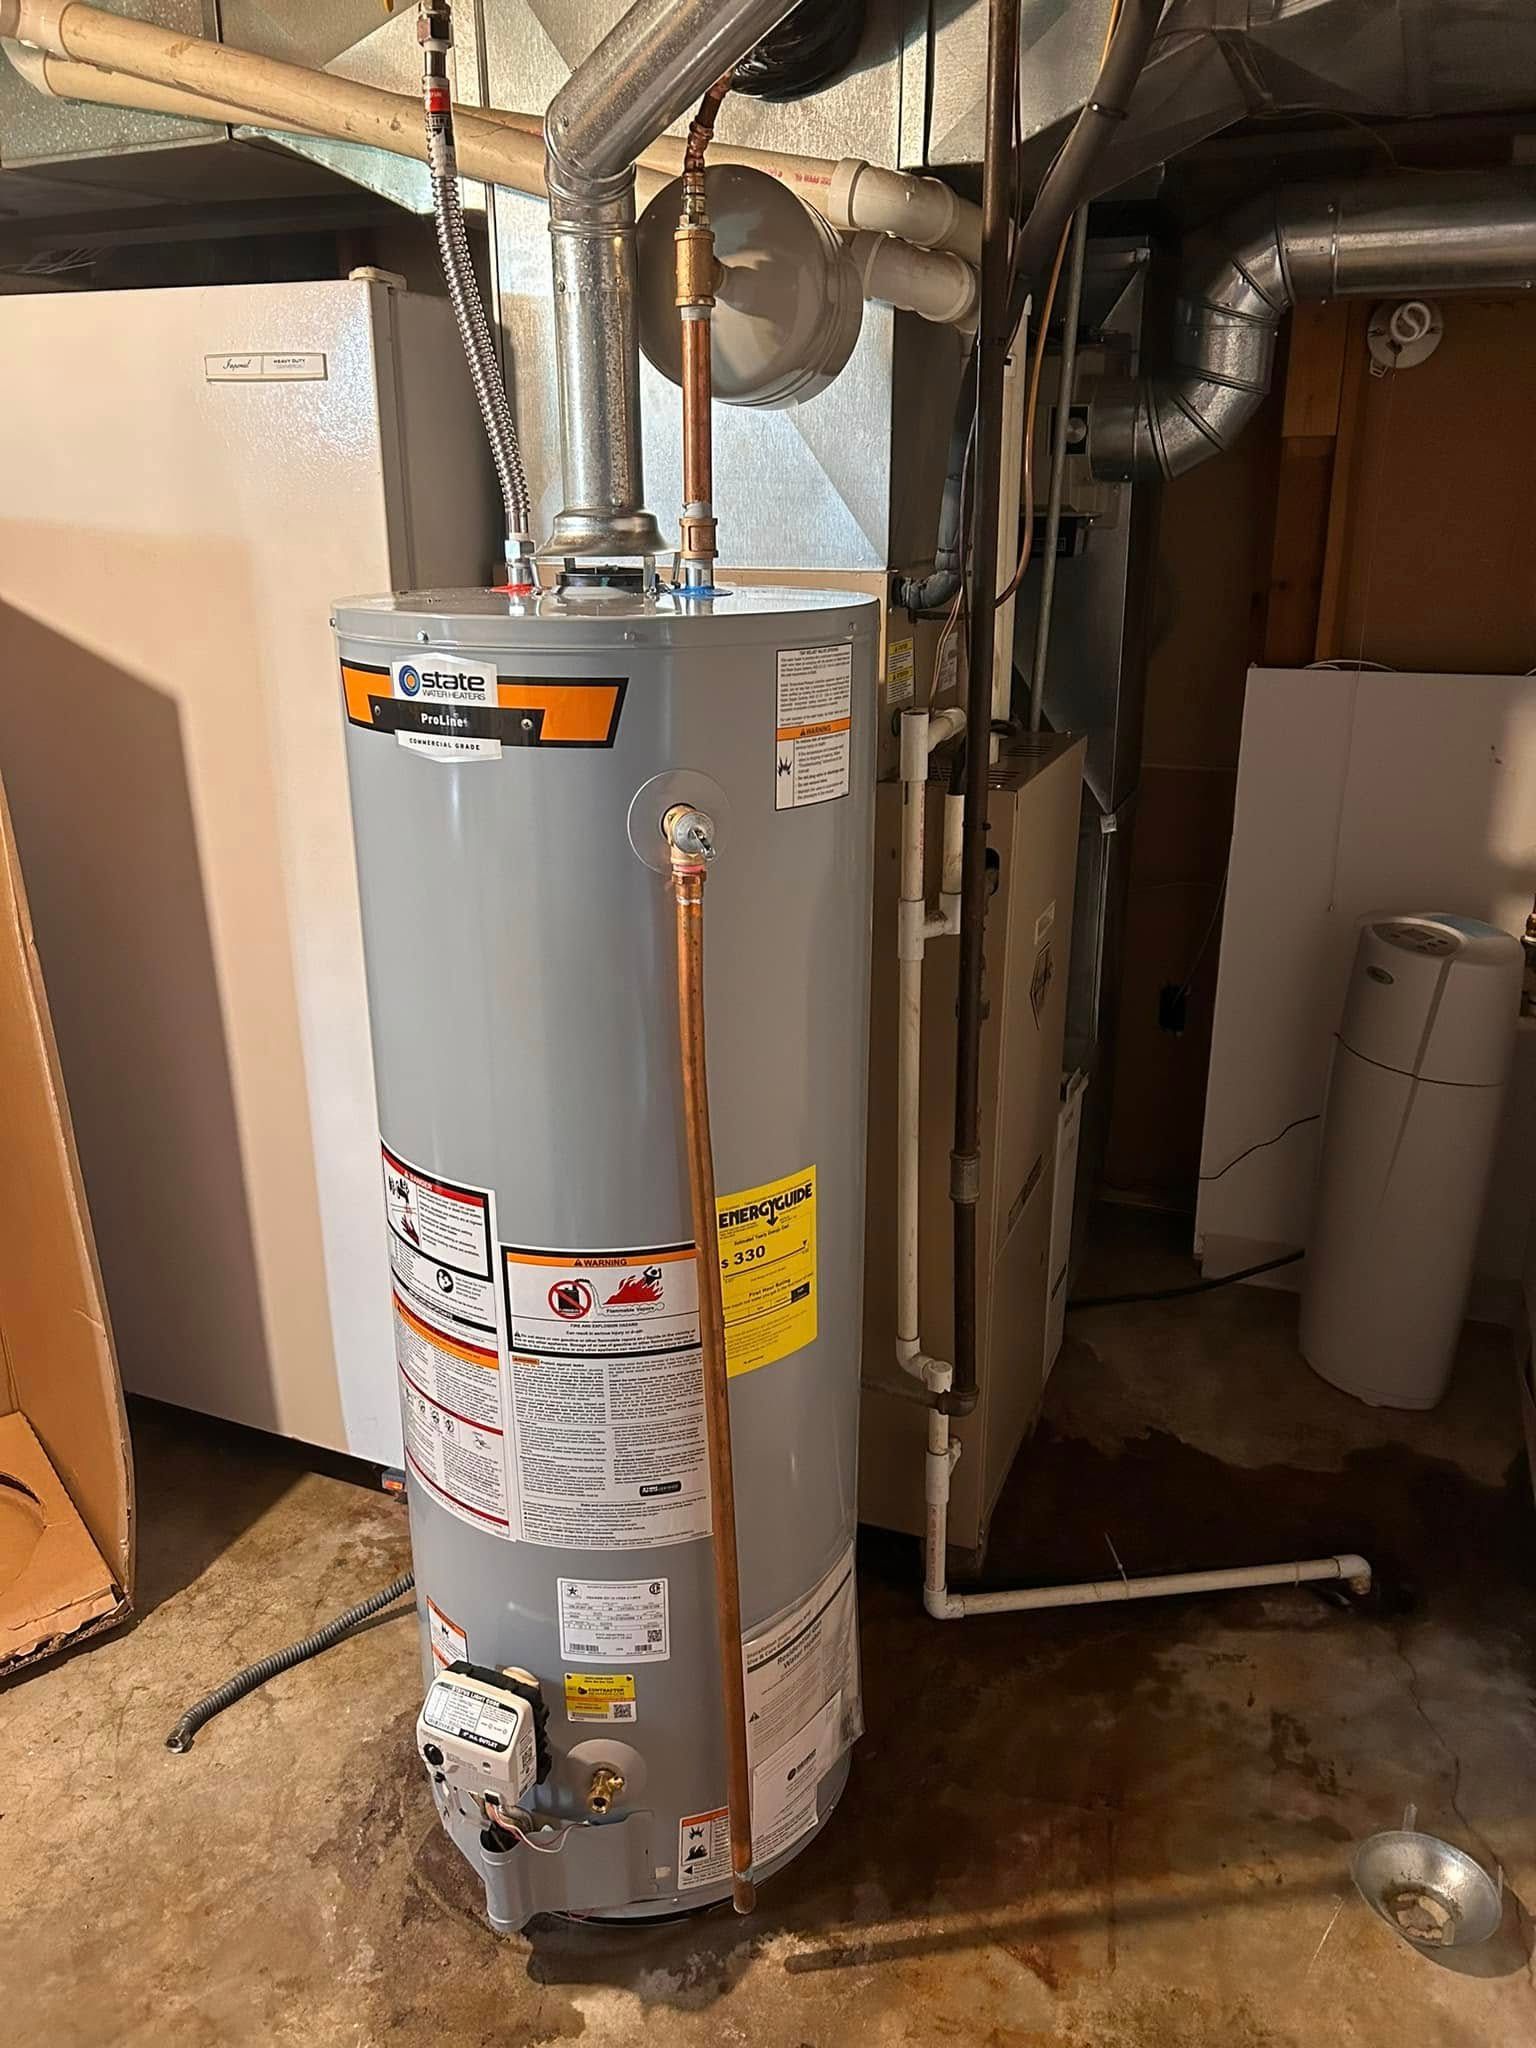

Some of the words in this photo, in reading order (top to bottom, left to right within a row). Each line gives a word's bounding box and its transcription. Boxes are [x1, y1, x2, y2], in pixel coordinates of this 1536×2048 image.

[422, 671, 485, 692] state
[422, 688, 447, 699] WATER
[448, 690, 486, 701] HEATERS
[409, 737, 452, 749] COMMERCIAL
[455, 742, 481, 751] GRADE
[719, 1183, 812, 1229] ENERGYGUIDE
[584, 1259, 628, 1267] WARNING
[734, 1245, 766, 1266] 330
